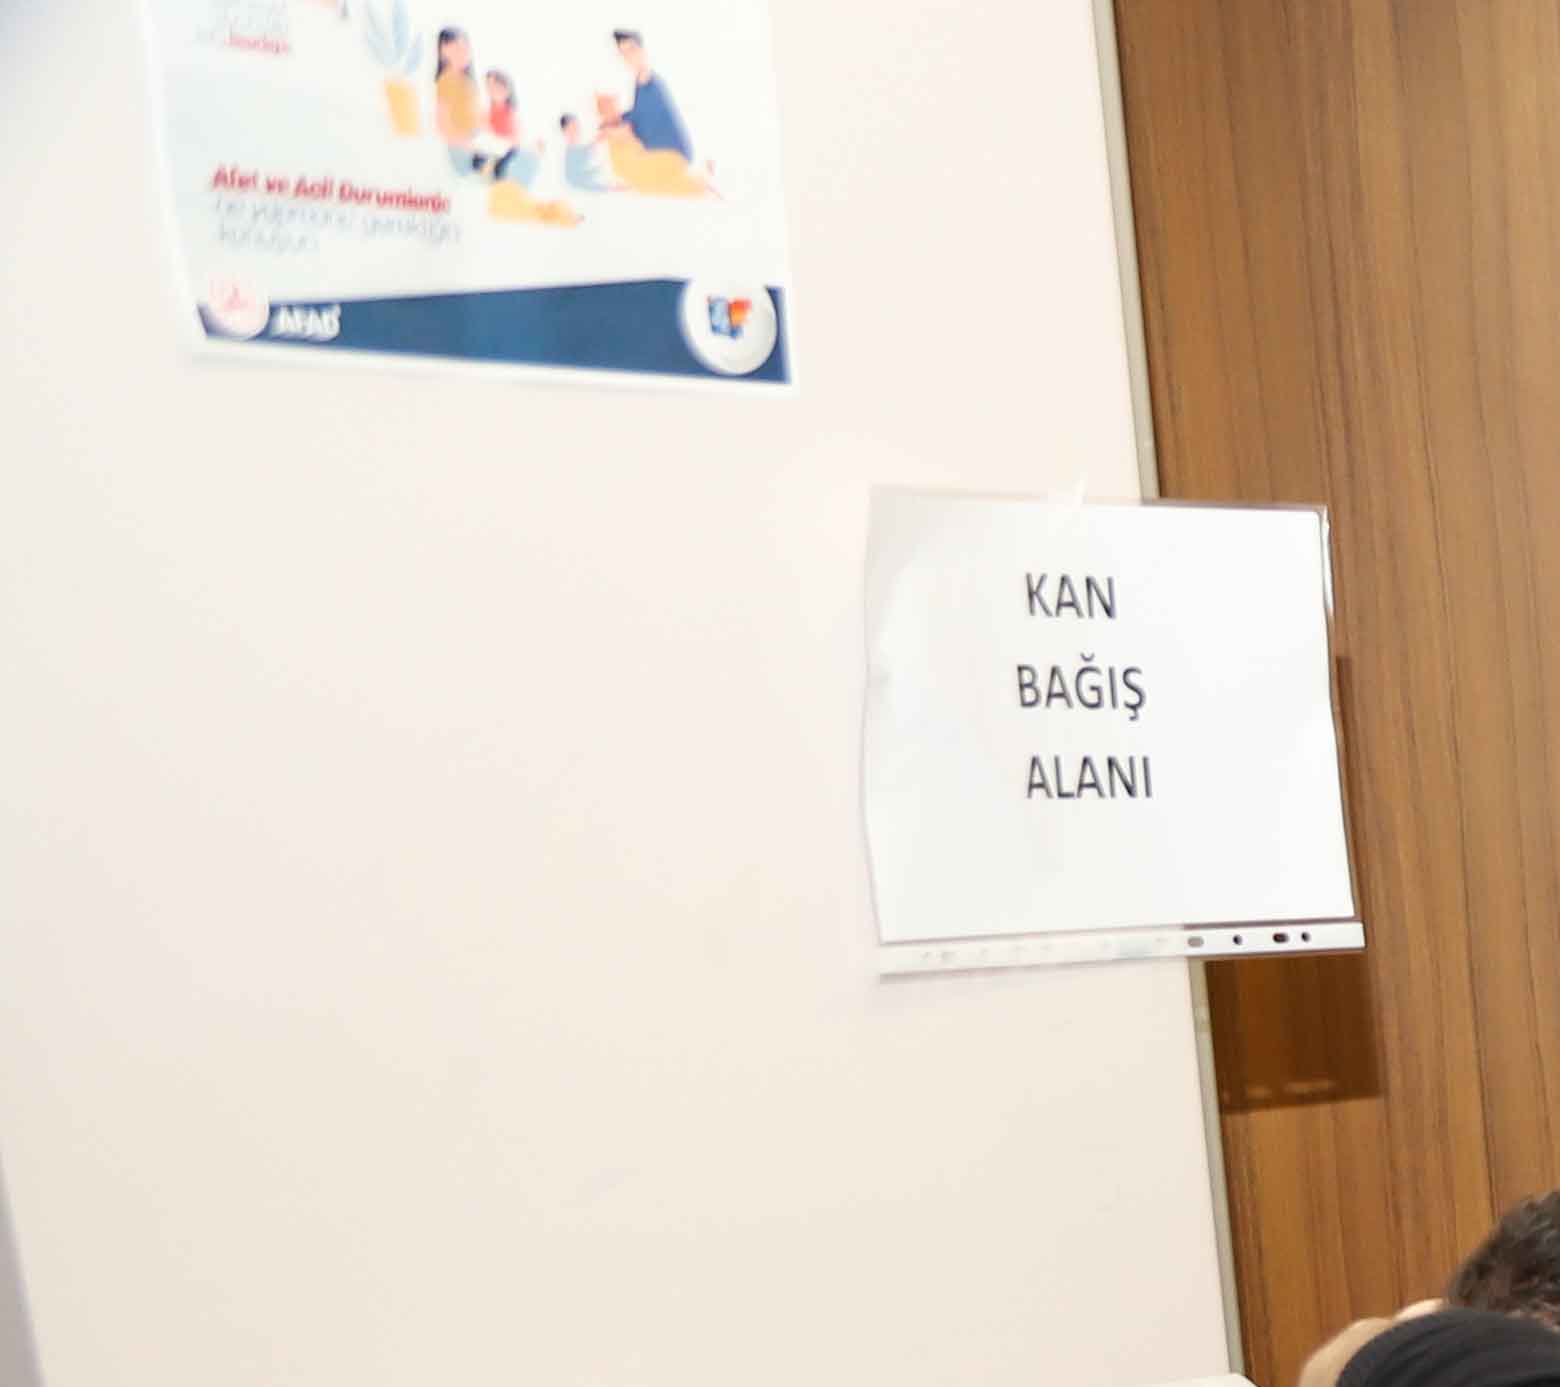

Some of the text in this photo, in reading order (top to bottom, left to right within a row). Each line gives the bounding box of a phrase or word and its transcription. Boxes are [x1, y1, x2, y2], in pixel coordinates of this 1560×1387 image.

[1025, 572, 1117, 619] KAN
[1016, 653, 1147, 721] BAĞIŞ
[1026, 755, 1153, 798] ALANI
